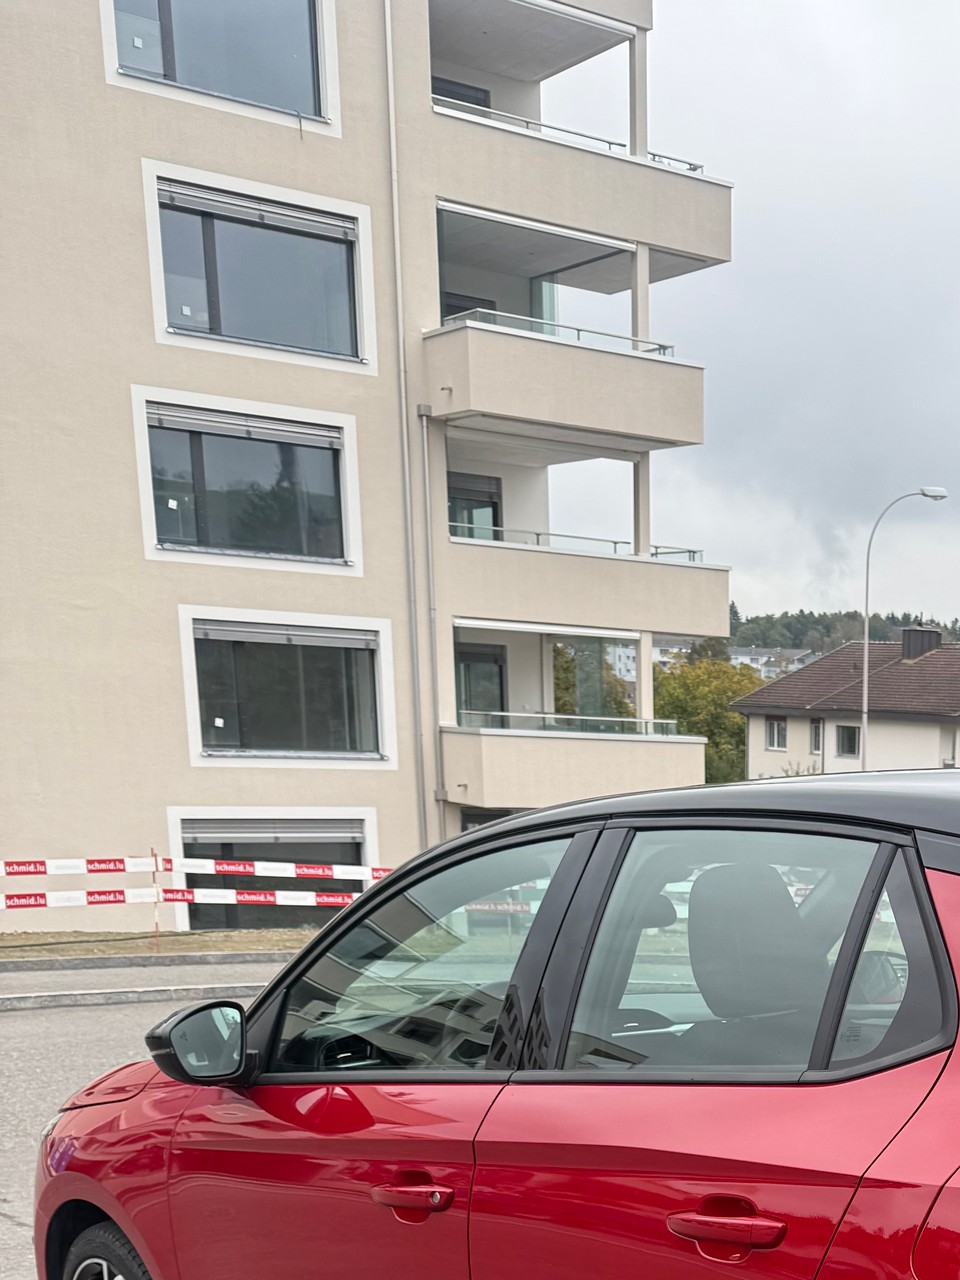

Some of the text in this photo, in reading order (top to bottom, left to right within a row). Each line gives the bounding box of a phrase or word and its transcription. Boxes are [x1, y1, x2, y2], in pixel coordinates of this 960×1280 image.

[5, 863, 45, 873] schmid.lu
[87, 860, 124, 871] schmid.lu
[215, 862, 254, 873] schmid.lu
[296, 866, 333, 876] schmid.lu
[6, 896, 46, 907] schmid.lu
[87, 891, 124, 902] schmid.lu
[236, 892, 275, 902] schmid.lu
[316, 895, 353, 904] schmid.lu
